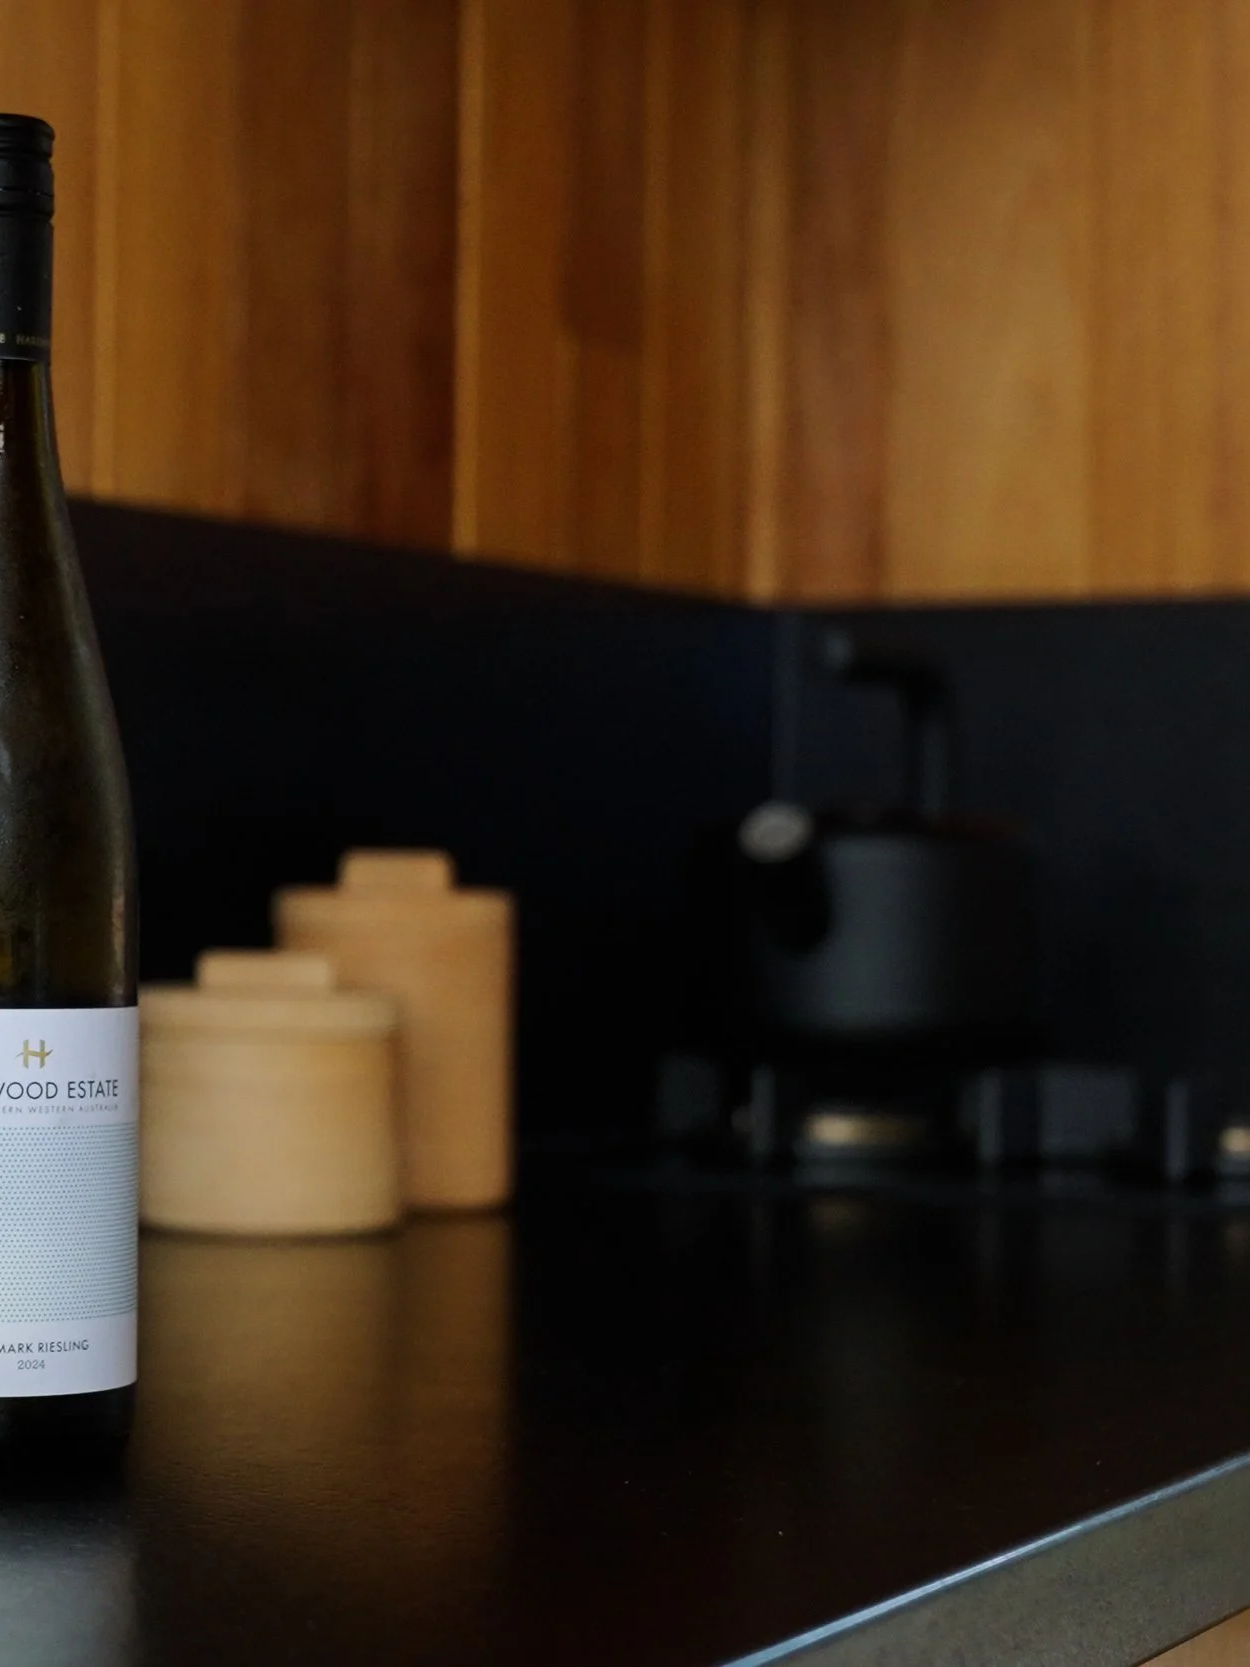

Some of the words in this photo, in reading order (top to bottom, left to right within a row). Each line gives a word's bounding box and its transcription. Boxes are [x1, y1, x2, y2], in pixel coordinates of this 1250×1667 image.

[67, 1079, 119, 1099] ESTATE
[28, 1104, 74, 1114] WESTERN
[37, 1339, 89, 1353] RIESLING
[17, 1359, 46, 1370] 2024
